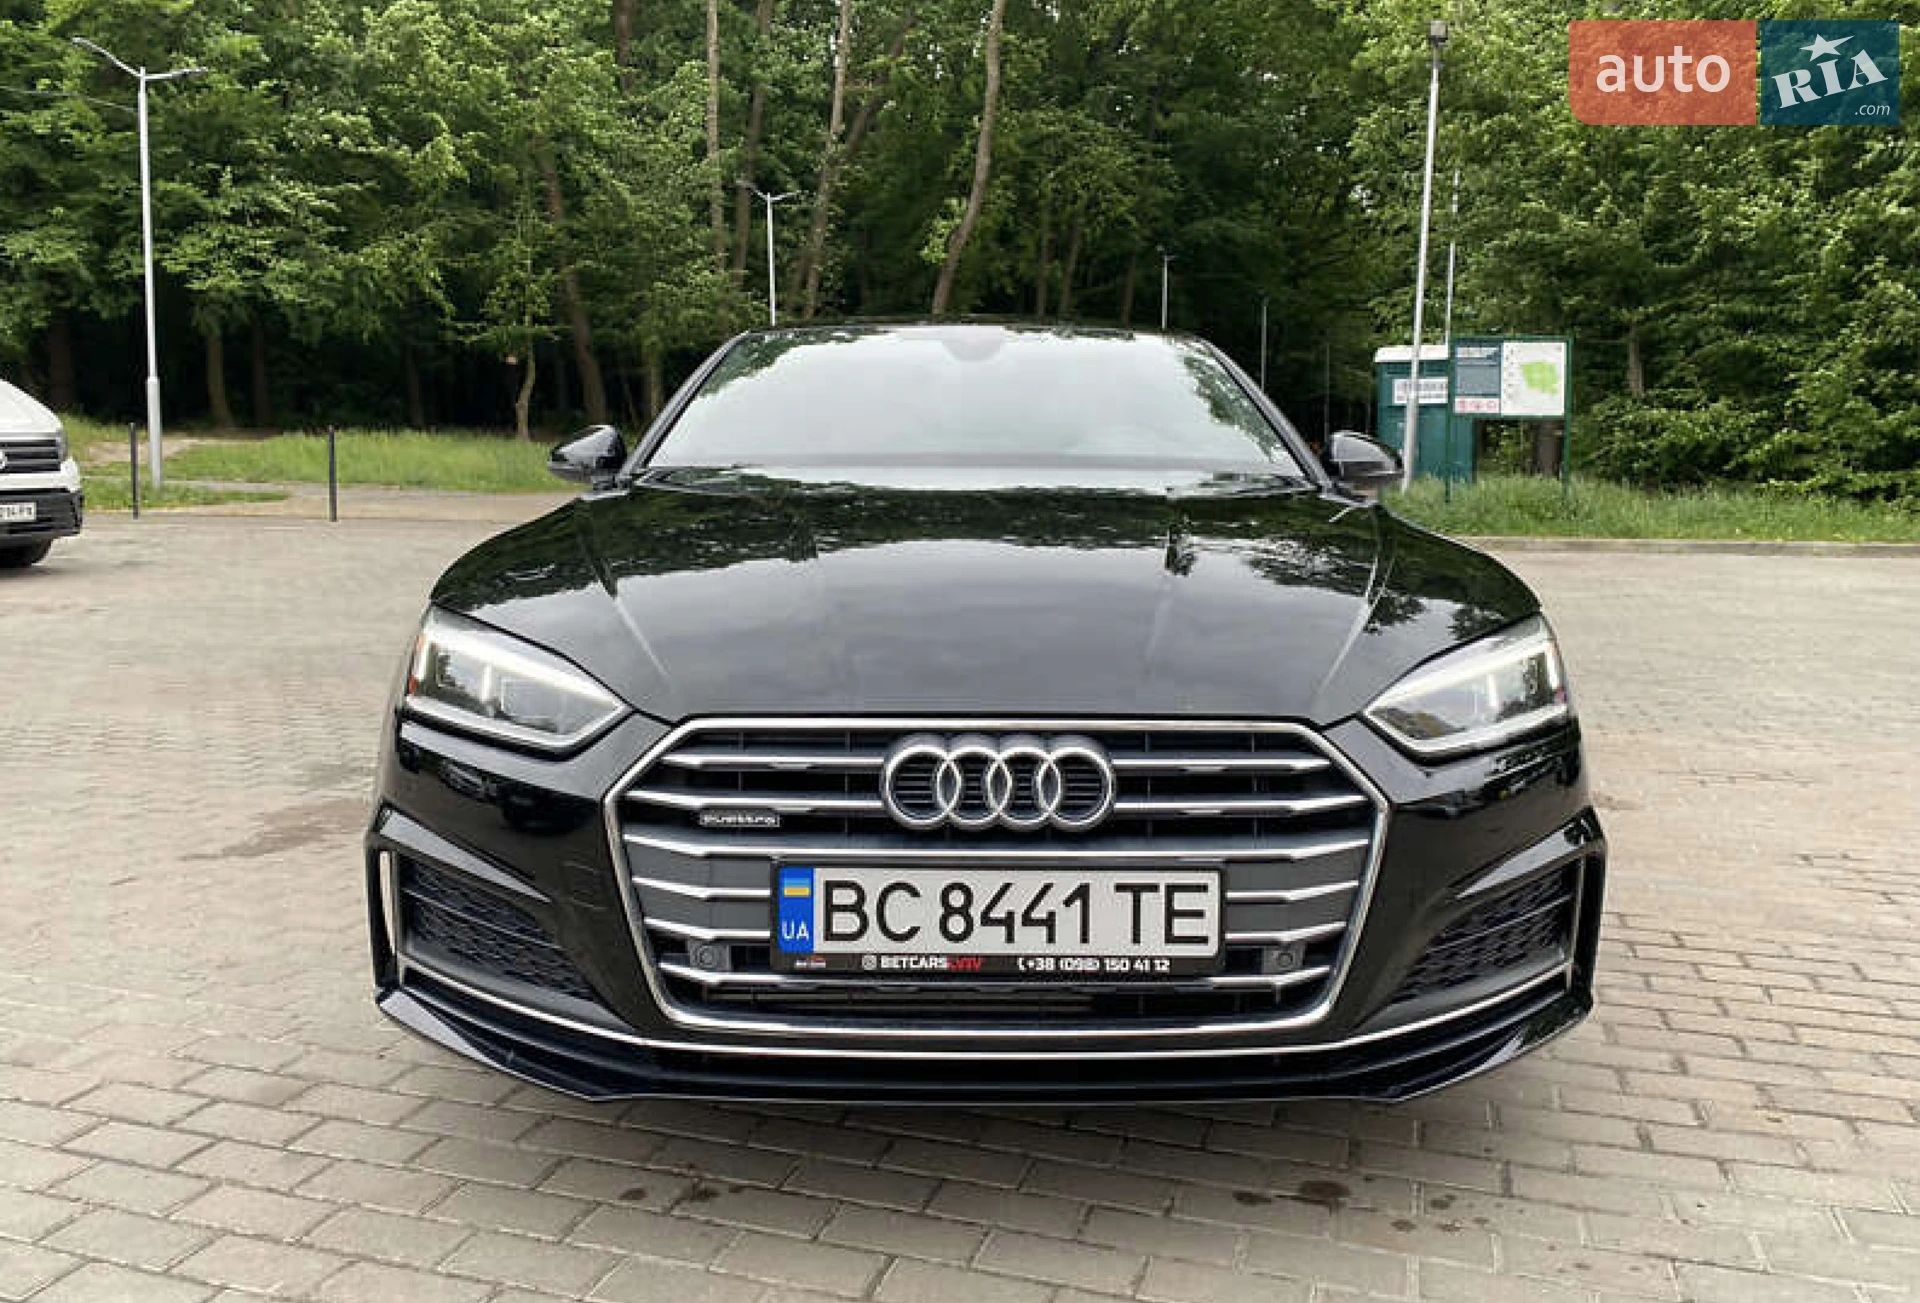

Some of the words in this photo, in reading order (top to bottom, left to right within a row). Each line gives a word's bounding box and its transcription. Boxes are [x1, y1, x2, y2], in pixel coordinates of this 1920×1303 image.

[824, 880, 921, 942] BC
[939, 882, 1091, 944] 8441
[1115, 884, 1209, 944] TE
[782, 921, 810, 940] UA
[1104, 957, 1130, 972] 150
[1133, 957, 1151, 971] 41
[1154, 957, 1171, 971] 12
